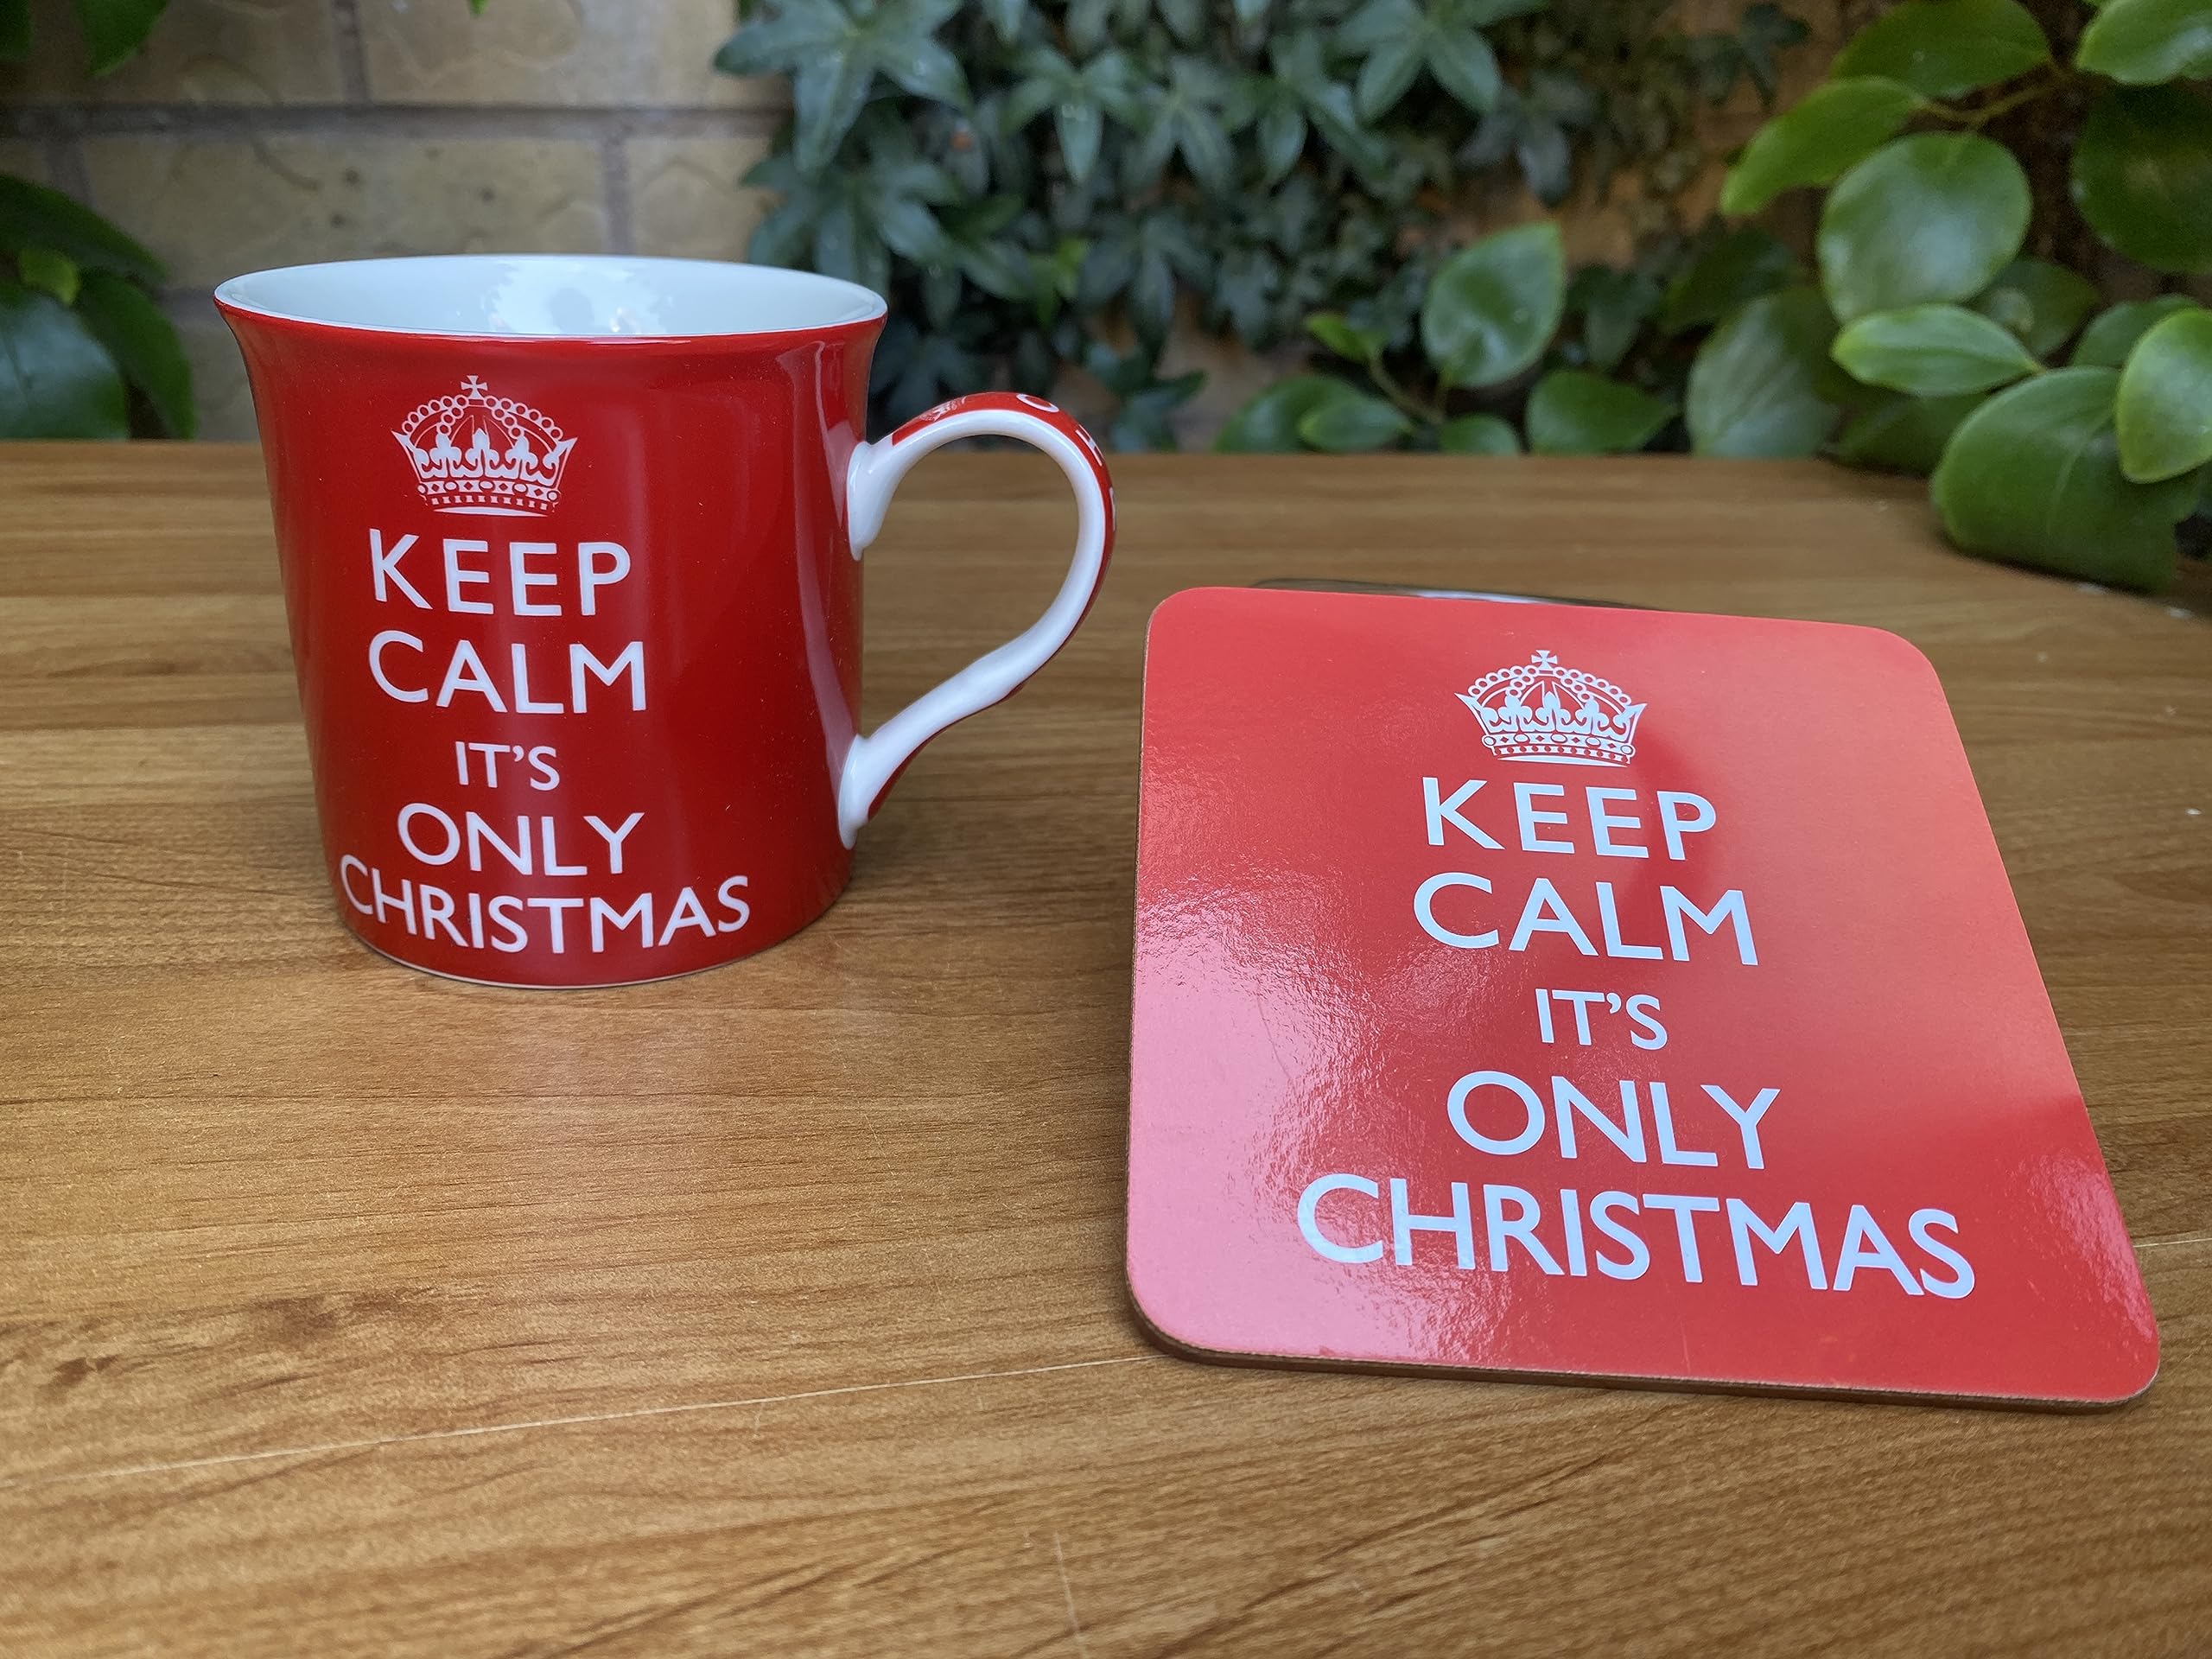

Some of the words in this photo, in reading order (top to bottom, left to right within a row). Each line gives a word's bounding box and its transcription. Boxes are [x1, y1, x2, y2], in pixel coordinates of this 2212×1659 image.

[369, 527, 632, 617] KEEP
[367, 629, 647, 715] CALM
[454, 741, 562, 791] IT'S
[397, 802, 645, 877] ONLY
[1422, 775, 1718, 861] KEEP
[340, 854, 751, 955] CHRISTMAS
[1413, 871, 1759, 967] CALM
[1534, 987, 1669, 1052] IT'S
[1446, 1069, 1782, 1171] ONLY
[1296, 1173, 1977, 1300] CHRISTMAS
